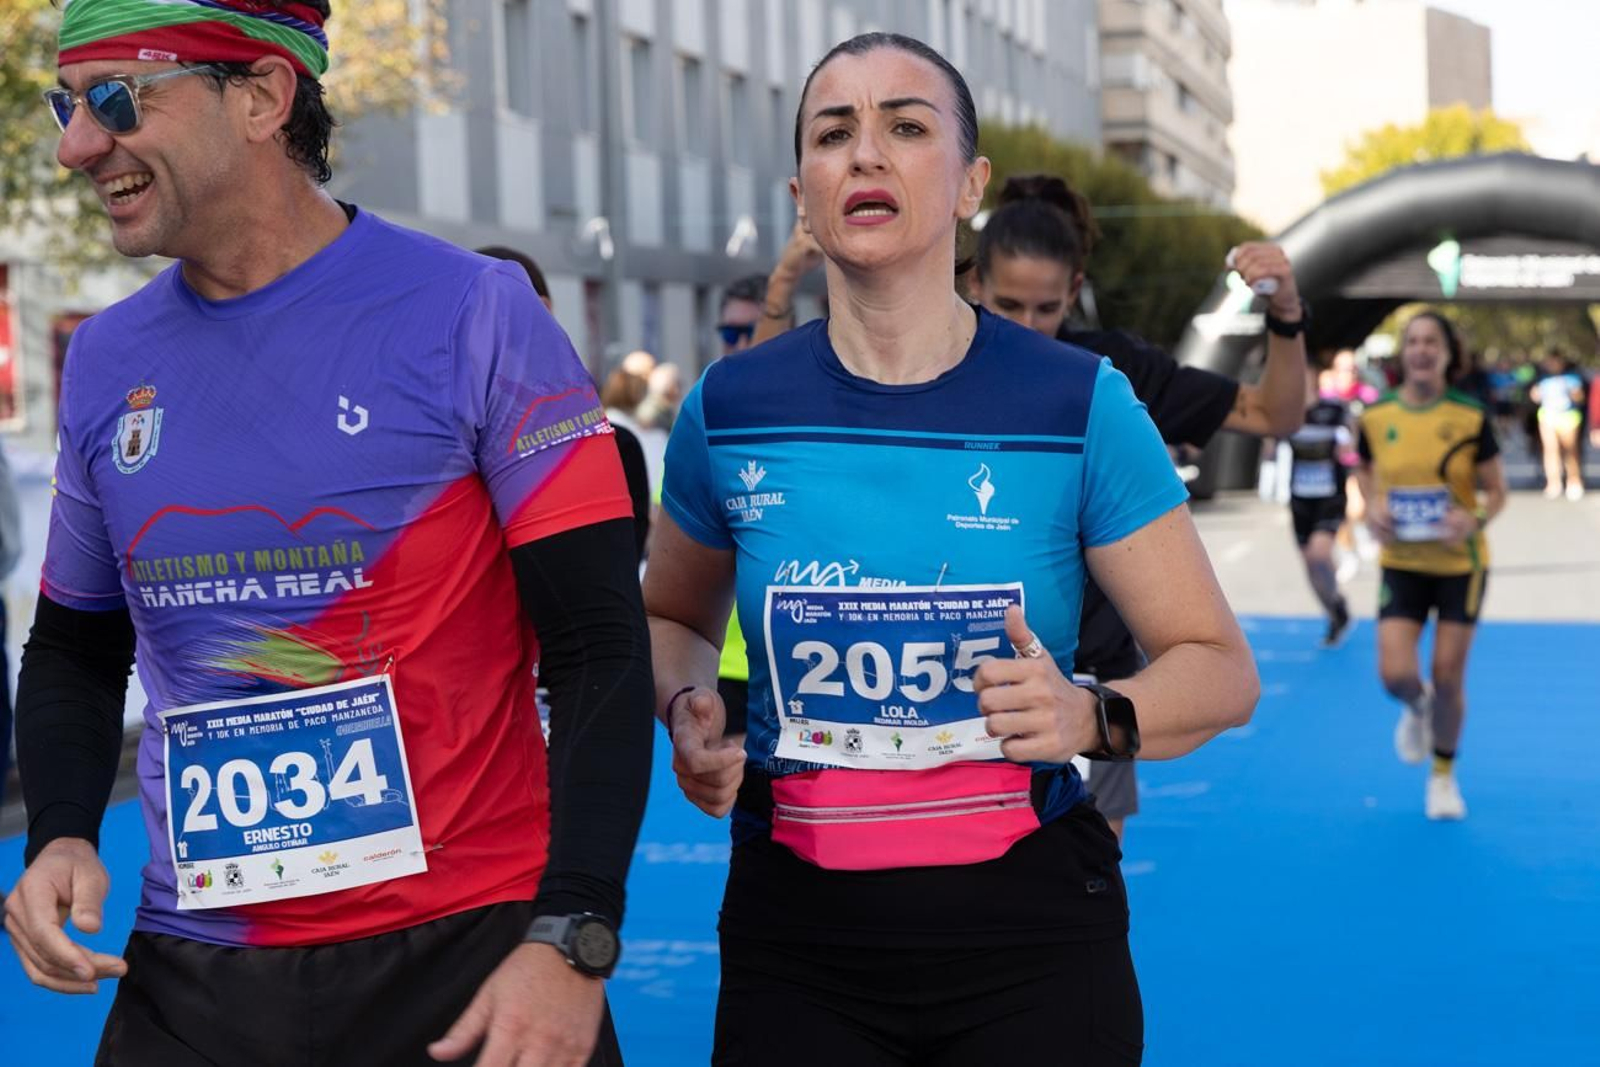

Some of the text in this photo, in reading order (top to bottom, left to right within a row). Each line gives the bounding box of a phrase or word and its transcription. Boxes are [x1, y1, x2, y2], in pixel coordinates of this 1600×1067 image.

[750, 492, 785, 507] RURAL
[133, 539, 365, 582] ATLETISMO Y MONTAÑA
[140, 568, 374, 608] MANCHA REAL
[839, 613, 844, 621] Y
[868, 612, 878, 621] EN
[883, 612, 919, 621] MEMORIA
[924, 612, 935, 621] DE
[940, 611, 961, 621] PACO
[861, 601, 887, 611] MEDIA
[889, 600, 931, 611] MARATÓN
[972, 600, 983, 609] DE
[206, 718, 225, 729] XXIX
[226, 715, 252, 728] MEDIA
[254, 707, 294, 723] MARATÓN
[336, 699, 349, 710] DE
[208, 732, 213, 741] Y
[234, 727, 245, 737] EN
[250, 723, 283, 736] MEMORIA
[288, 720, 299, 730] DE
[305, 716, 327, 728] PACO
[332, 705, 384, 722] MANZANEDA
[881, 705, 918, 719] LOLA
[181, 738, 388, 833] 2034
[243, 823, 312, 845] ERNESTO
